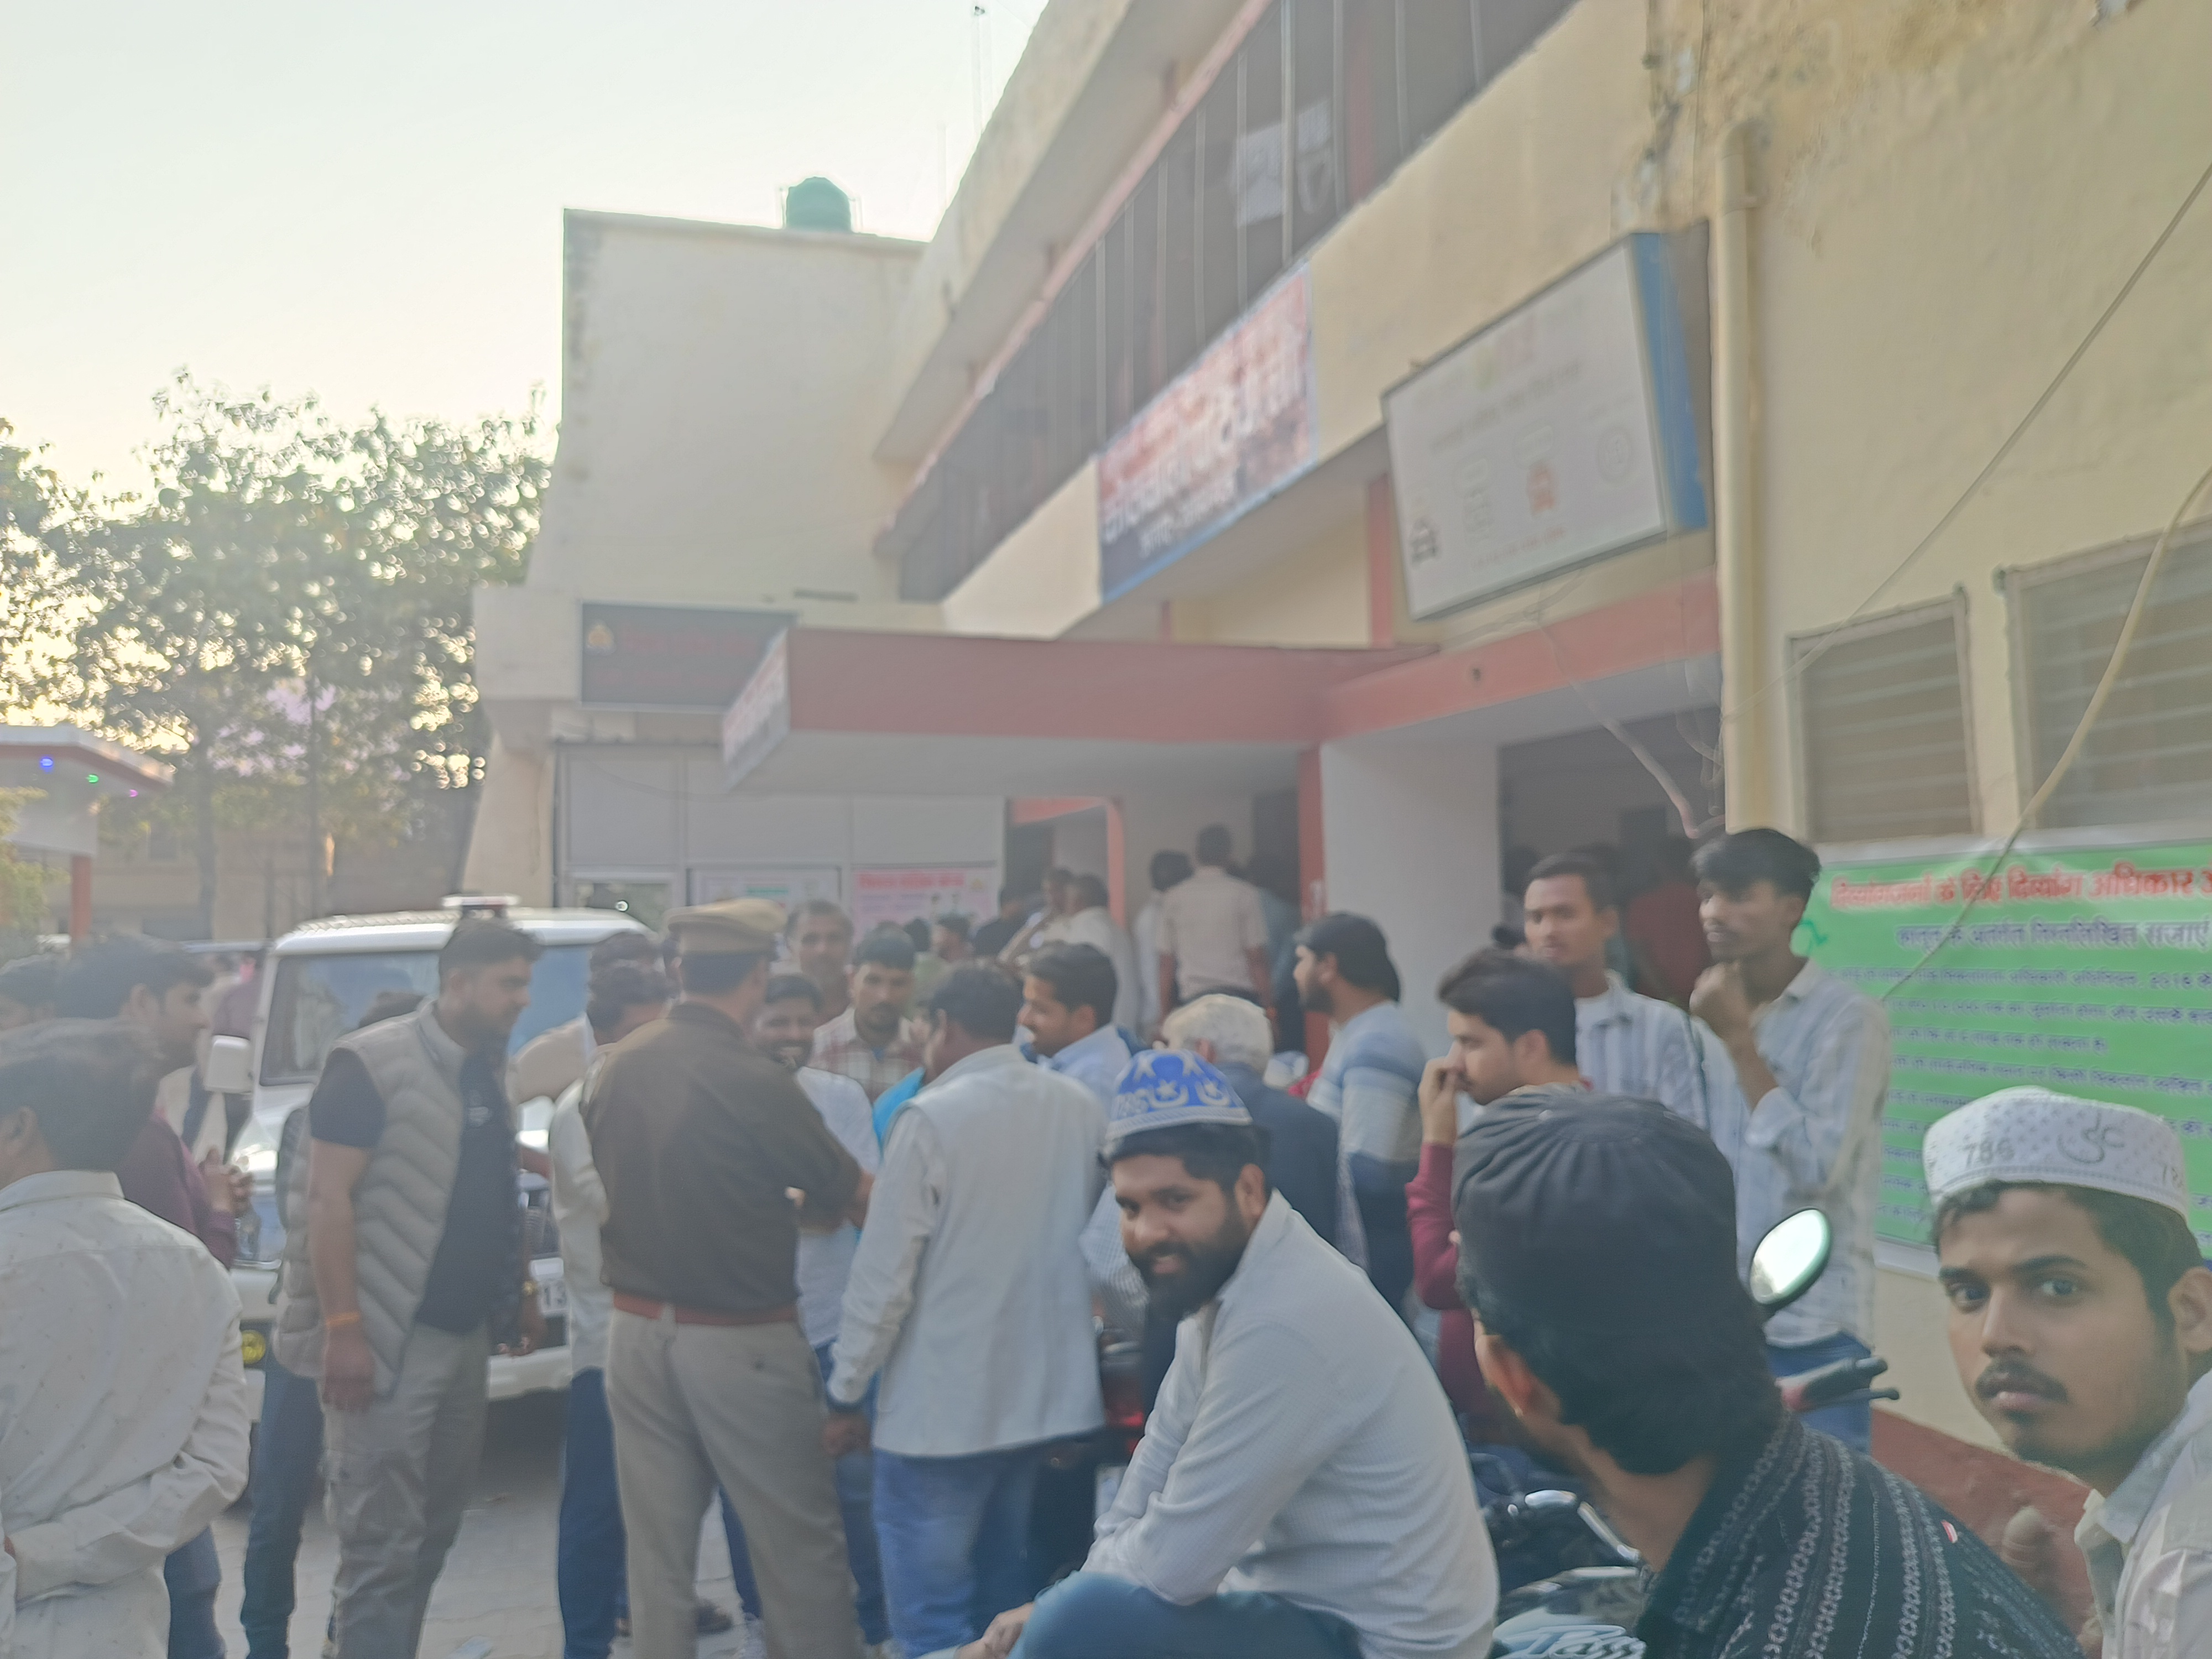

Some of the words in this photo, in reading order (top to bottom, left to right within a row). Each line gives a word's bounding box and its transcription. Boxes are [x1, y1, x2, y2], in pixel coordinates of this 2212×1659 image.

[1938, 876, 1955, 901] के
[2008, 865, 2083, 899] दिव्यांग
[2090, 862, 2194, 897] अधिकार
